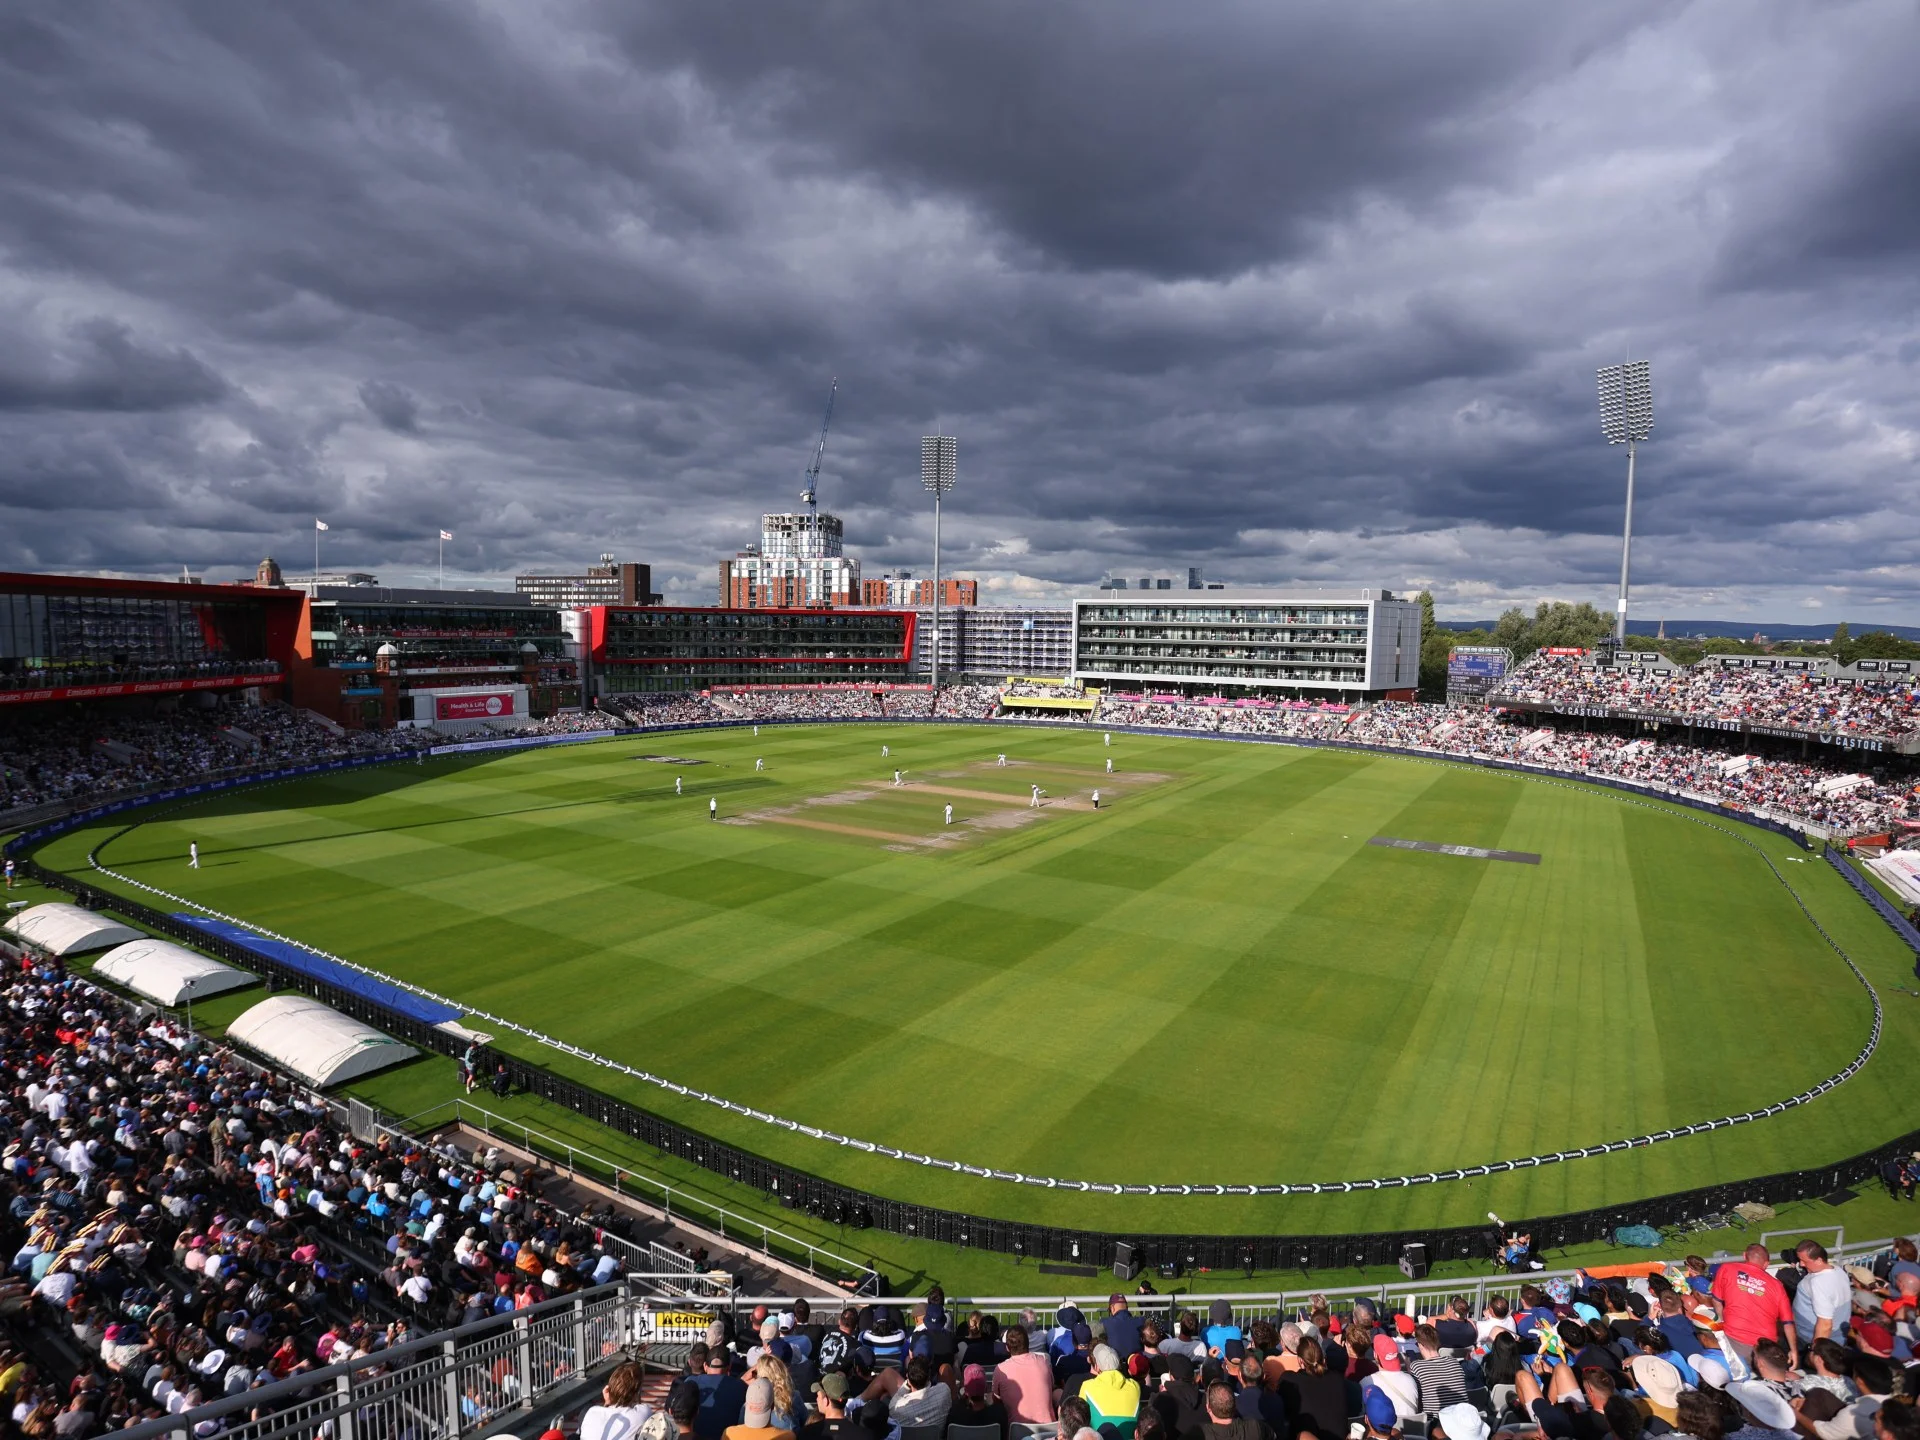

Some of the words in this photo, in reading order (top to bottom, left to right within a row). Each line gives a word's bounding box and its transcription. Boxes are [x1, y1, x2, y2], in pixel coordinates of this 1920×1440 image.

[66, 688, 96, 696] Emirates
[1568, 707, 1609, 718] CASTORE
[1697, 720, 1741, 732] CASTORE
[1772, 729, 1790, 737] NEVER
[434, 744, 464, 753] Rothesay
[1836, 736, 1882, 751] CASTORE
[1737, 1279, 1765, 1292] LEAGUE
[675, 1316, 715, 1324] CAUTIO
